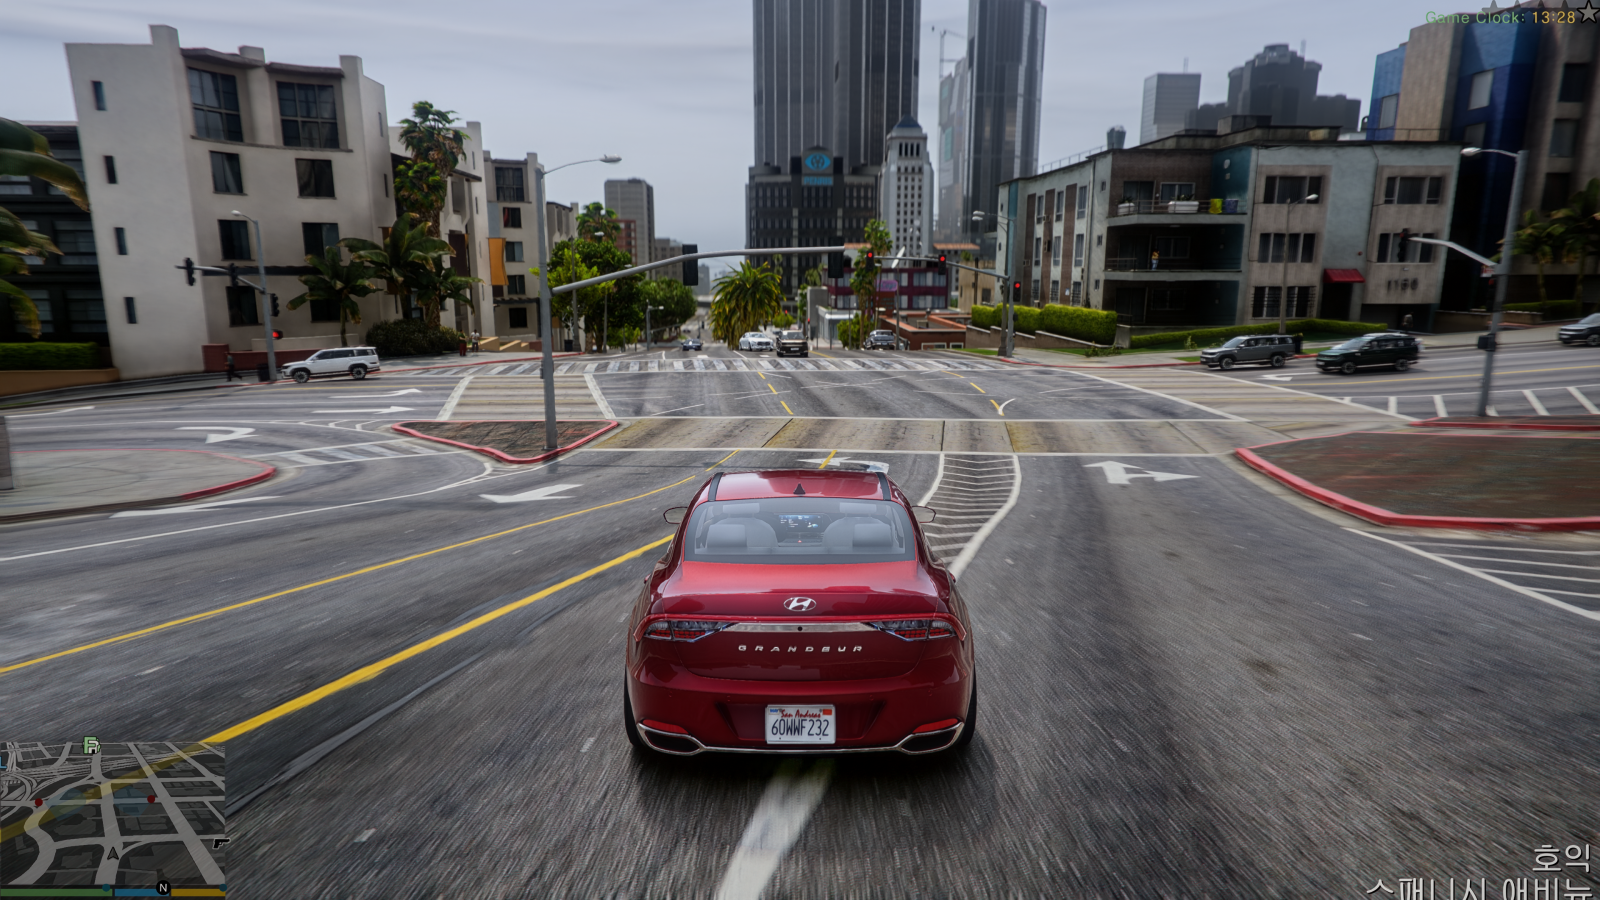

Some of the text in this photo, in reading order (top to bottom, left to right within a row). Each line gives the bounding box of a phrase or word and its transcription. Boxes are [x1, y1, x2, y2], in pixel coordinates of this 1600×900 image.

[738, 645, 862, 653] GRANDEUR
[780, 708, 821, 719] San Andreas
[771, 718, 830, 737] 60WWF232
